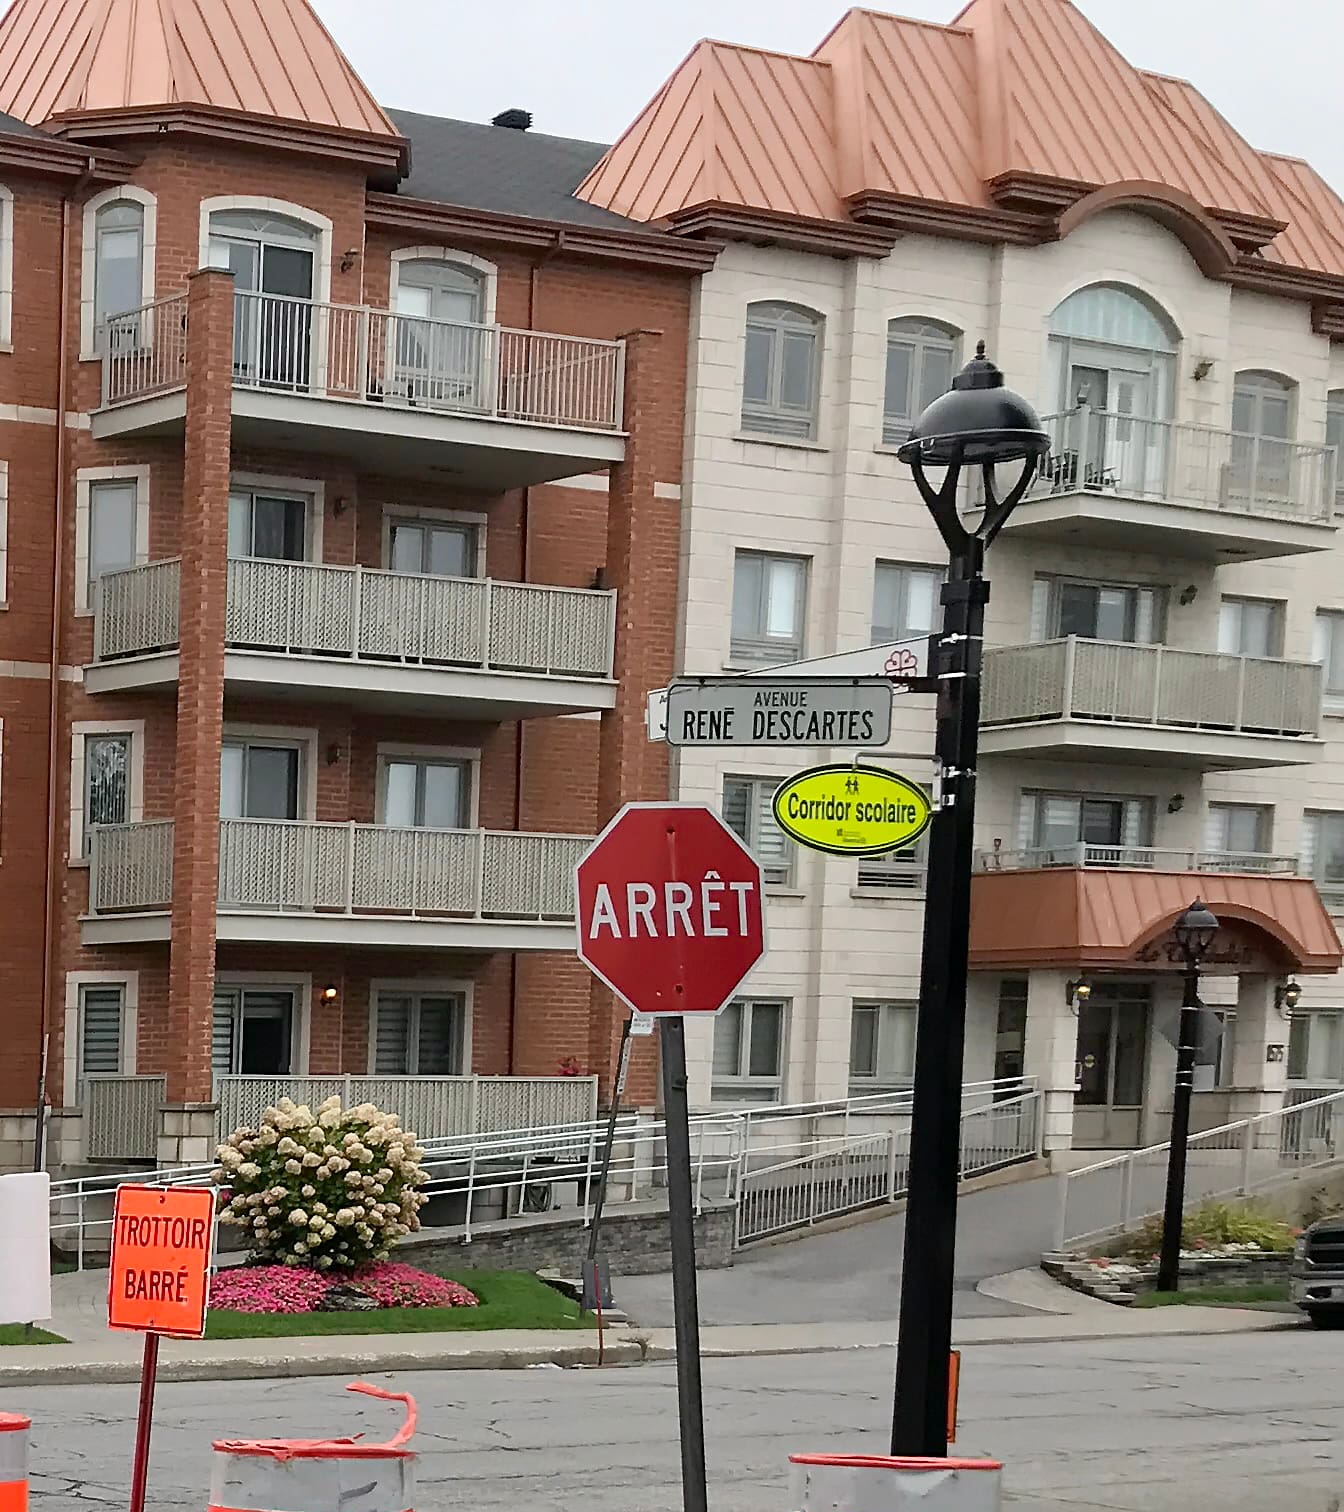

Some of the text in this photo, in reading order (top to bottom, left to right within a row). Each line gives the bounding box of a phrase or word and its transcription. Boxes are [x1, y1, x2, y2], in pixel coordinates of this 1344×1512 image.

[753, 691, 809, 708] AVENUE
[682, 707, 874, 741] RENÉ DESCARTES
[787, 792, 917, 826] Corridor scolaire
[589, 870, 754, 939] ARRÊT
[119, 1215, 206, 1250] TROTTOIR
[124, 1266, 189, 1303] BARRÉ
